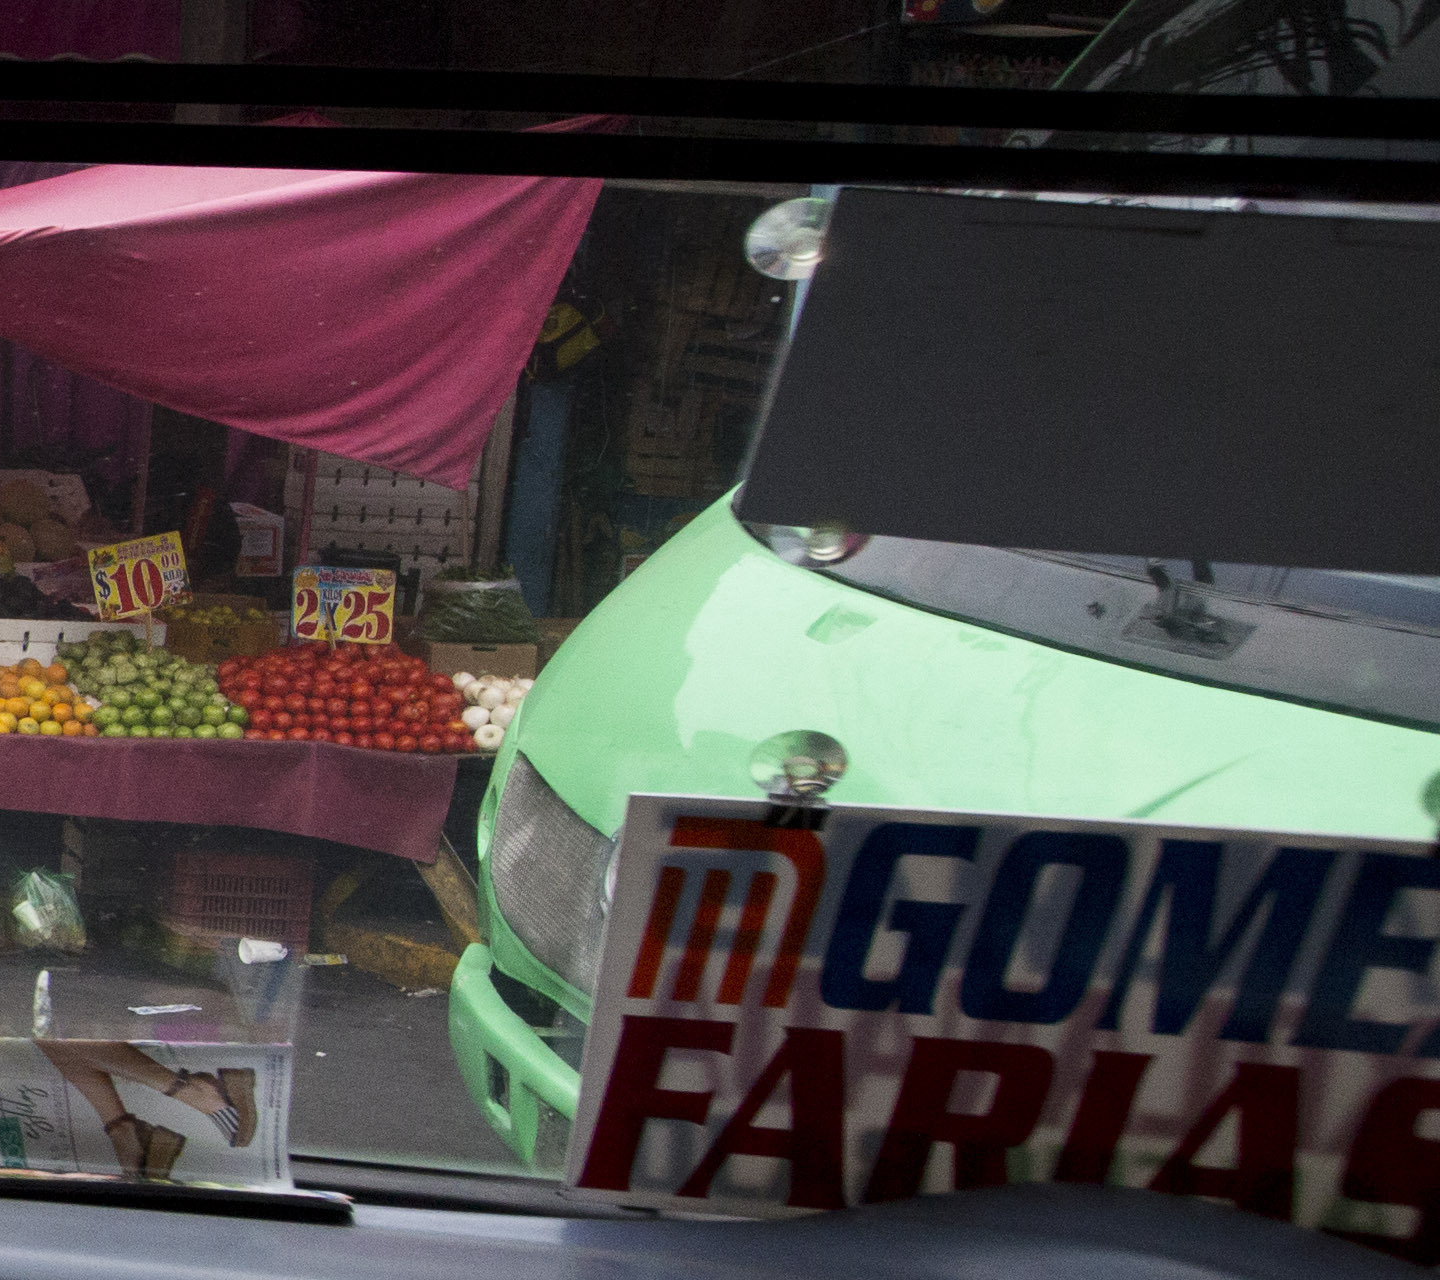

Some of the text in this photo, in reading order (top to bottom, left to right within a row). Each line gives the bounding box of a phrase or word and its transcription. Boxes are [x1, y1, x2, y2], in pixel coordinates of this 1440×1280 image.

[296, 588, 319, 637] 2
[342, 590, 391, 640] 25
[822, 820, 1440, 1058] GOME
[577, 1013, 1440, 1266] FARIAS
